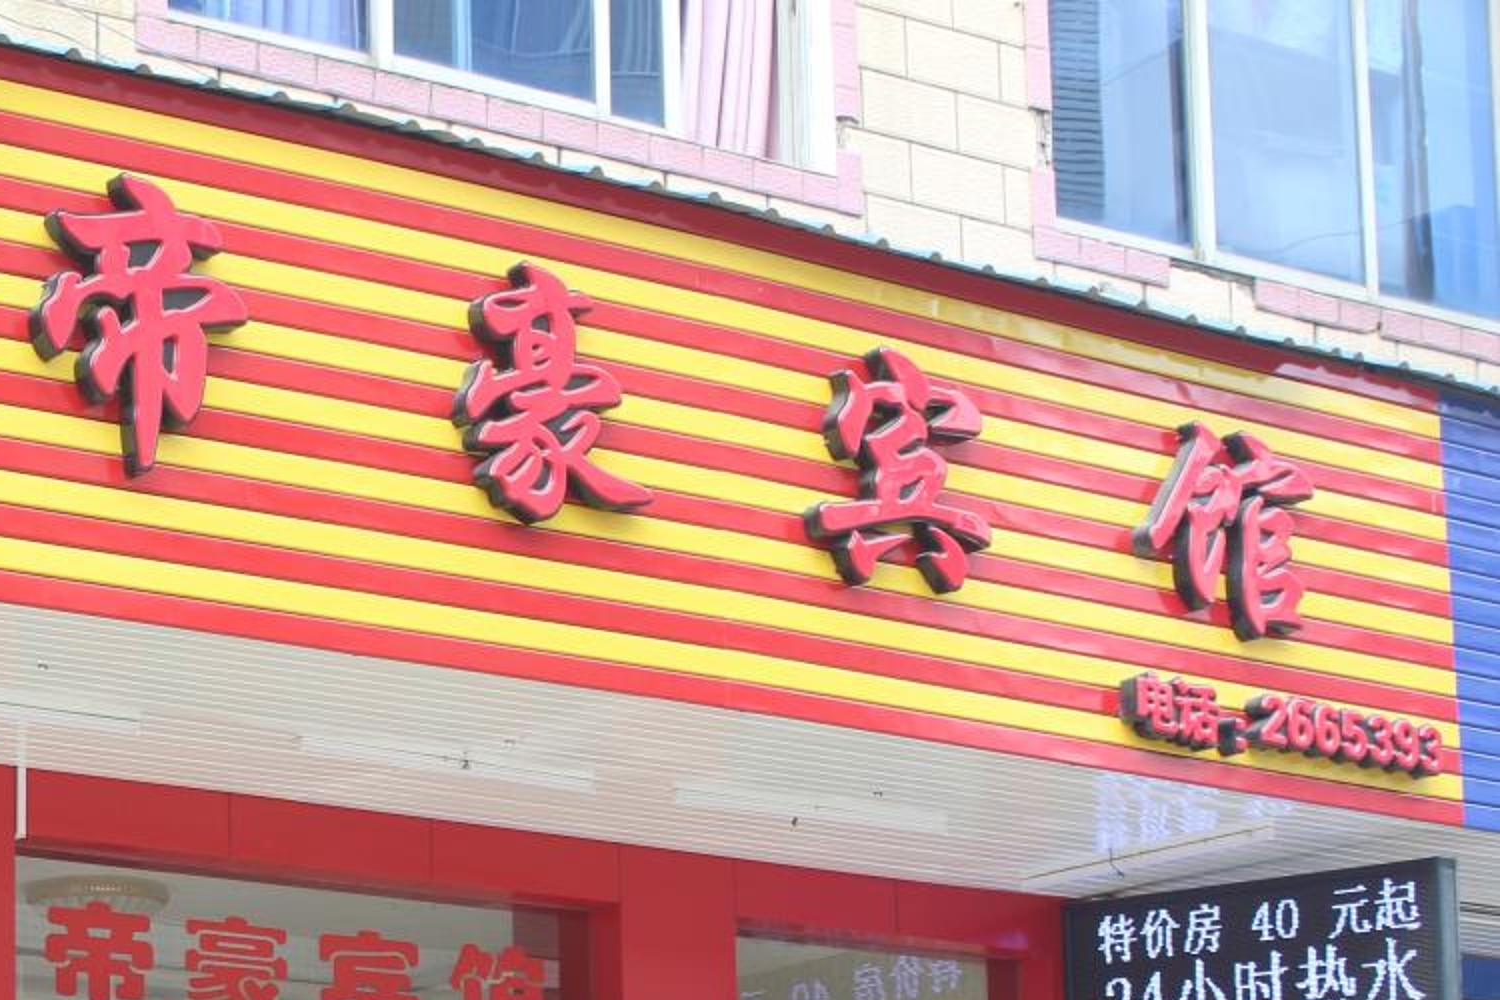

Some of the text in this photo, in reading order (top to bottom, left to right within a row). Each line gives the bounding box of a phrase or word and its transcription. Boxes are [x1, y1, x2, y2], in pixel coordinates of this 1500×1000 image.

[29, 170, 1314, 642] 帝豪宾馆
[1097, 877, 1423, 964] 特价房 40 元起
